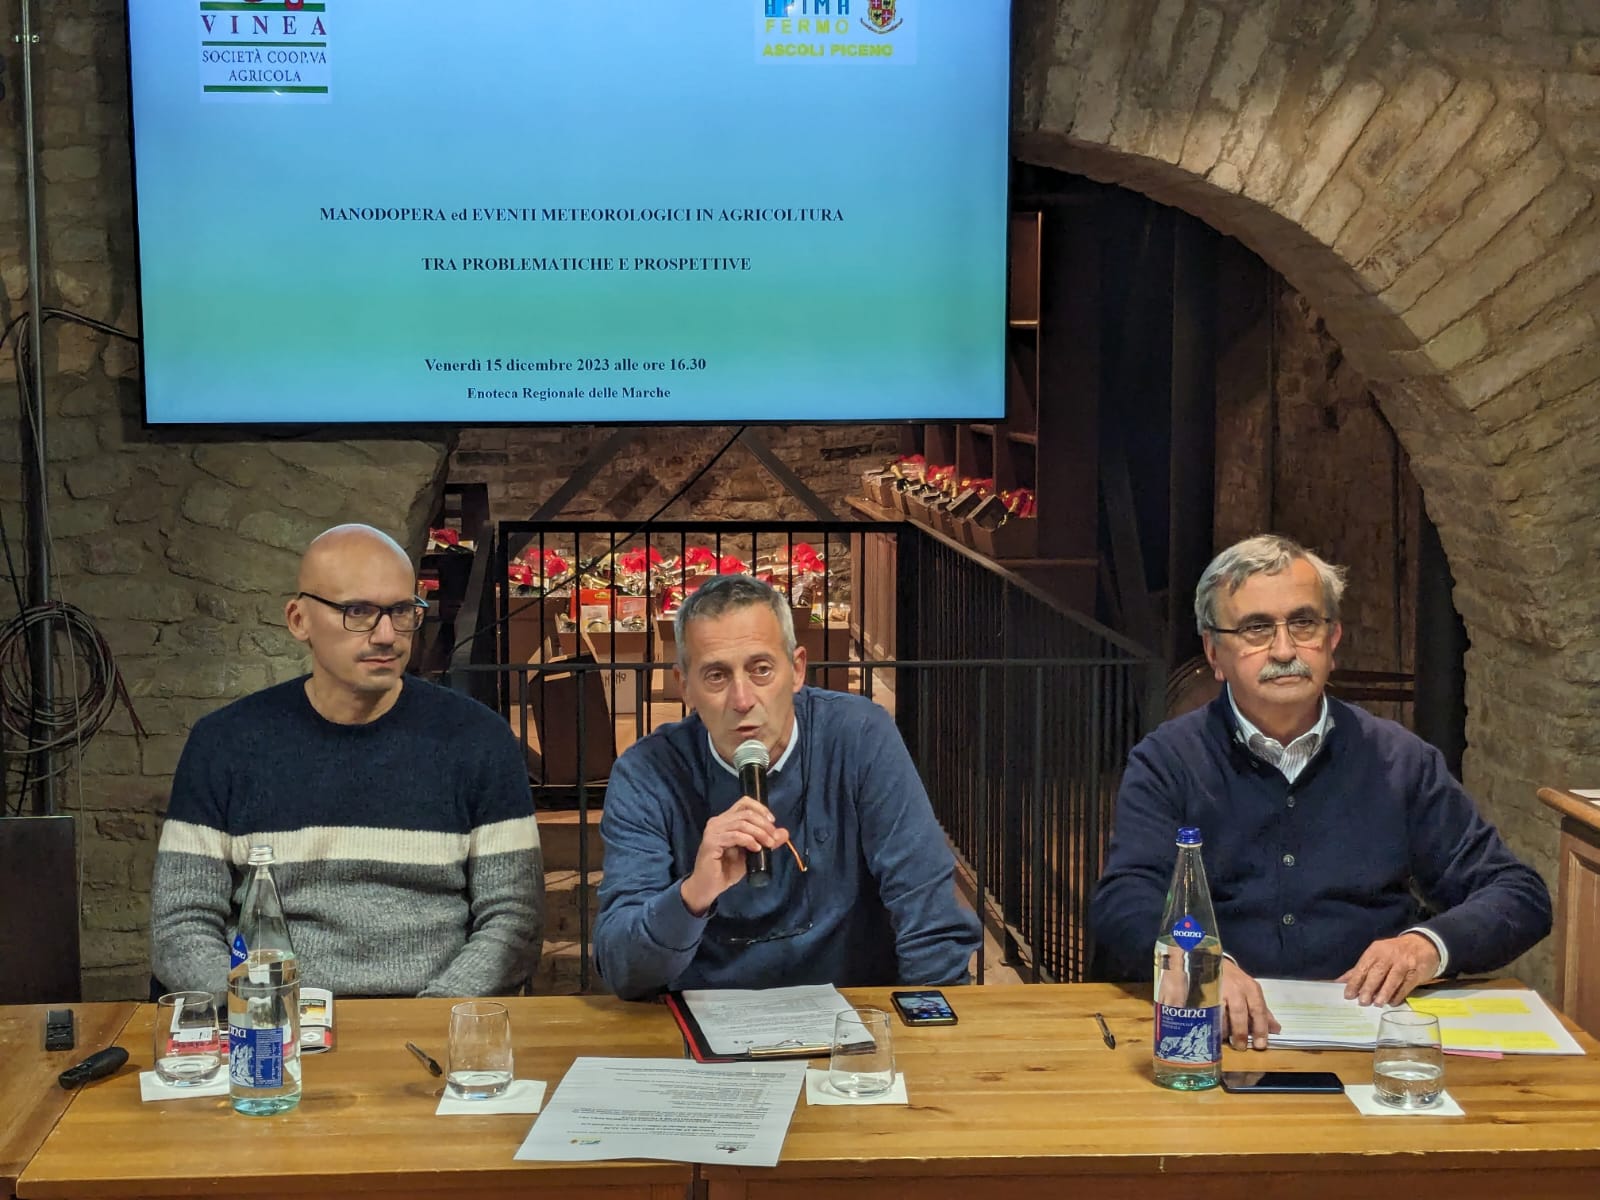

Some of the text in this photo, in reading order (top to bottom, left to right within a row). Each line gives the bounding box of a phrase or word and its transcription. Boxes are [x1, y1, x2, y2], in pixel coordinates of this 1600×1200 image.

[200, 14, 327, 36] VINEA
[765, 18, 849, 35] FERMO
[202, 48, 263, 64] SOCIETÀ
[763, 43, 894, 57] ASCOLI PICENO
[229, 69, 302, 83] AGRICOLA
[319, 207, 844, 222] MANODOPERA ed EVENTI METEOROLOGICI IN AGRICOLTURA
[421, 257, 752, 271] TRA PROBLEMATICHE E PROSPETTIVE
[425, 357, 707, 372] Venerdì 15 dicembre 2023 alle ore 16.30
[467, 386, 671, 401] Enoteca Regionale delle Marche
